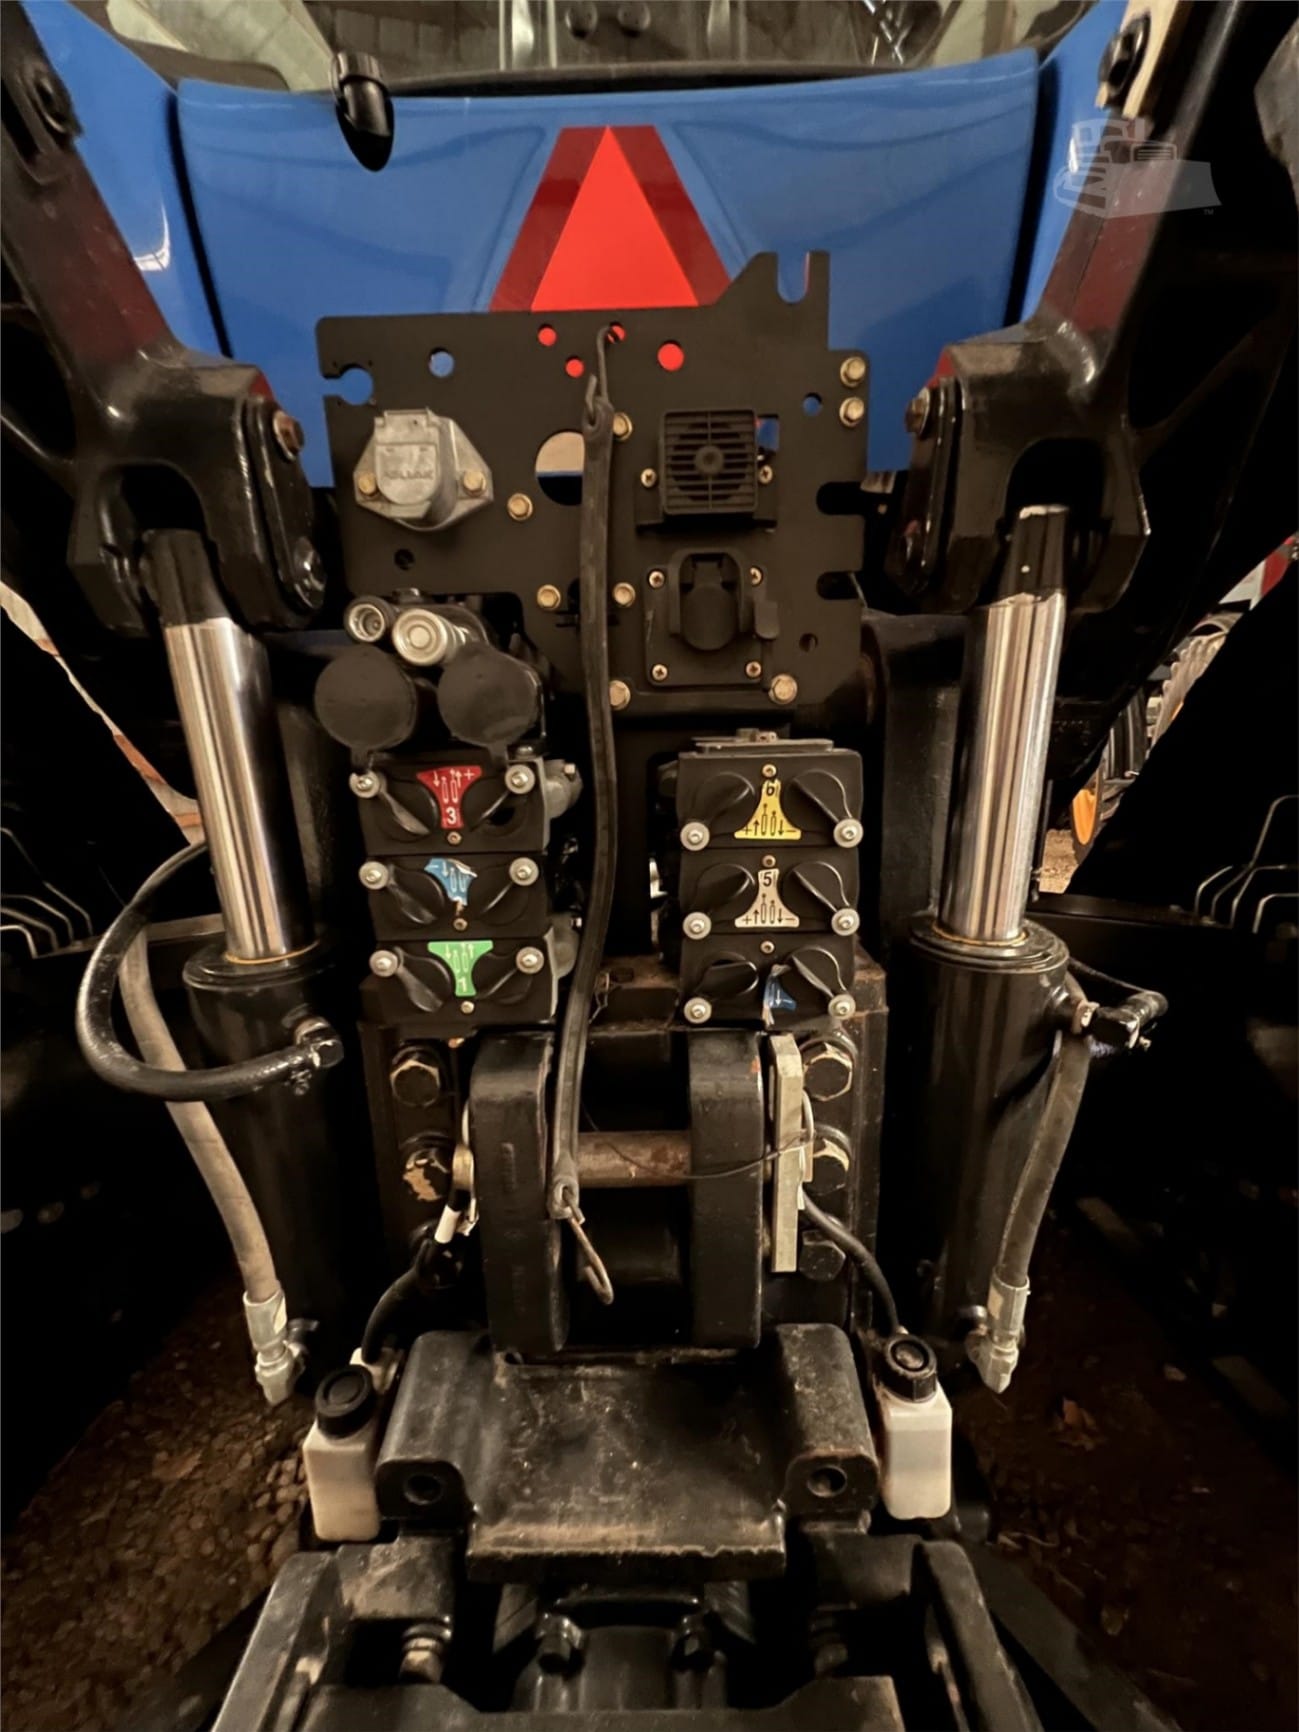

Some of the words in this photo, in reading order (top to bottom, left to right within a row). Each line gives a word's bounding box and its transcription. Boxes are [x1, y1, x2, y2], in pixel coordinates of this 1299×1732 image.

[765, 779, 775, 795] 6
[446, 806, 457, 825] 3
[762, 871, 772, 887] 5
[457, 979, 467, 993] 1
